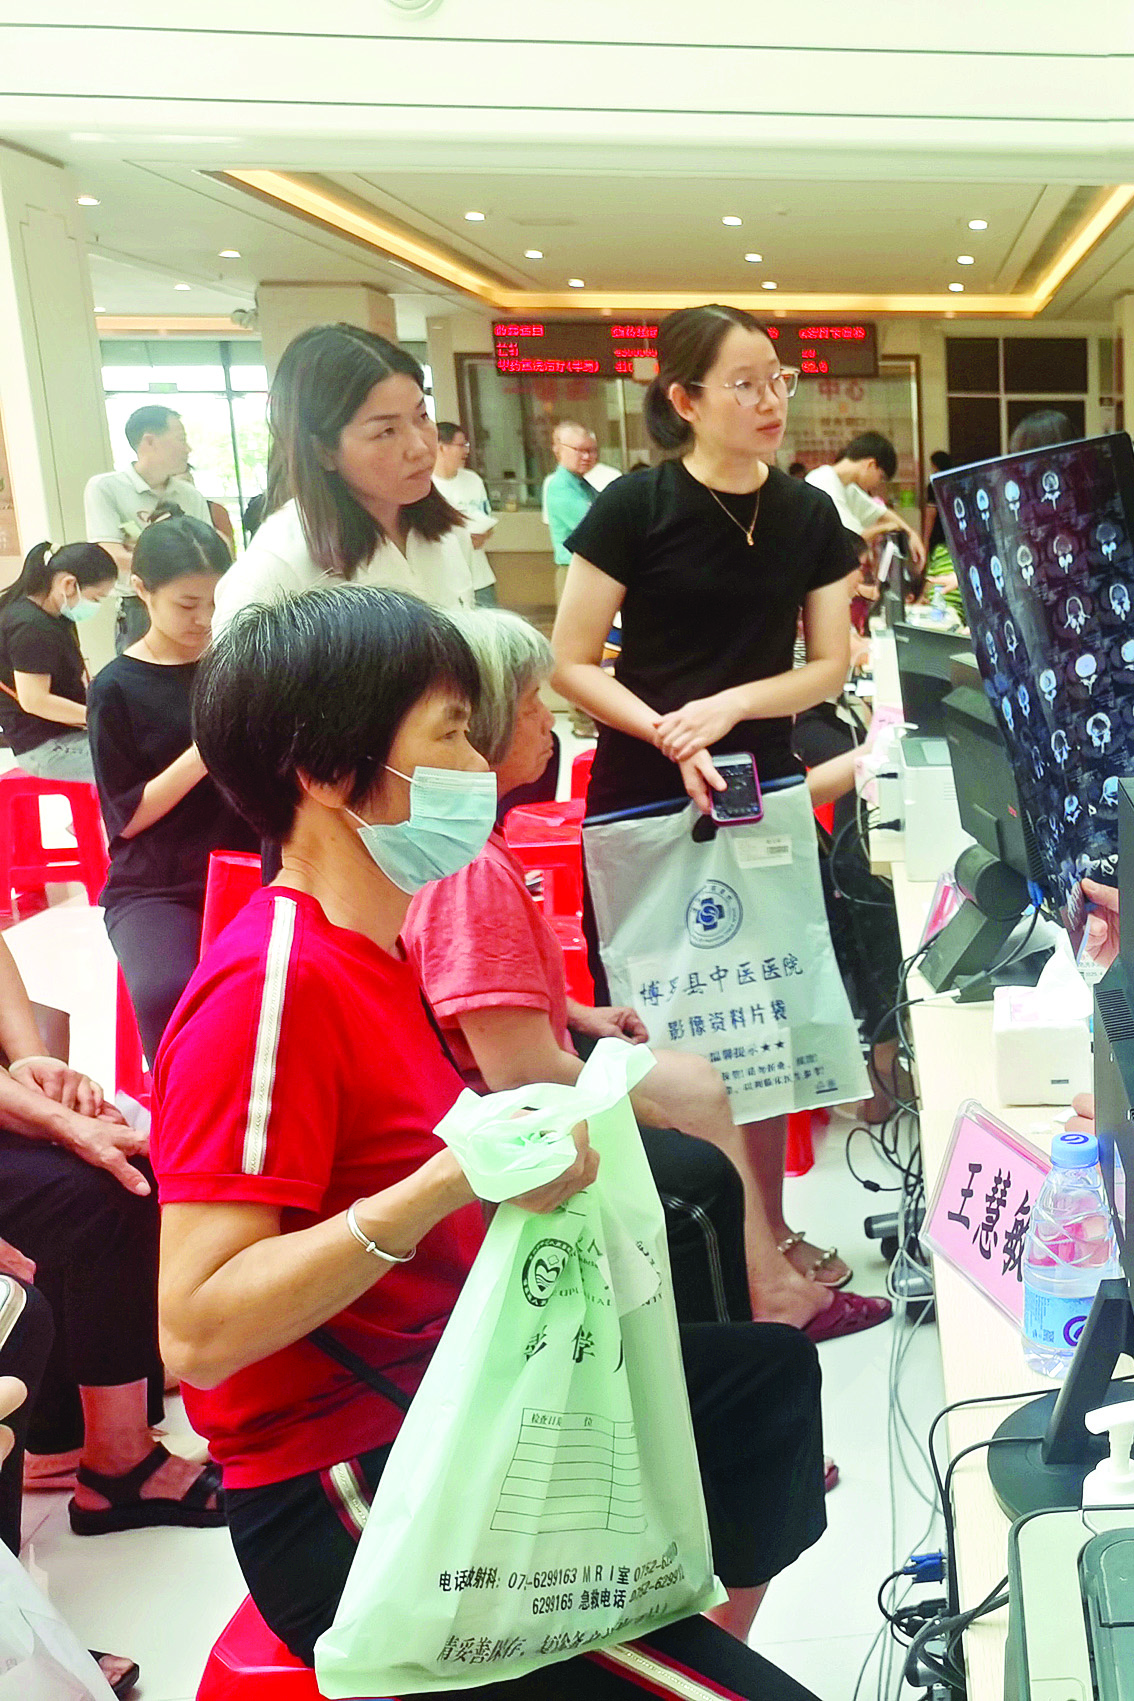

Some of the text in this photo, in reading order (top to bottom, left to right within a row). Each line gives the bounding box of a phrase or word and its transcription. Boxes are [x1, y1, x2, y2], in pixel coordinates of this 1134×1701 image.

[667, 999, 788, 1041] 影像资料片袋
